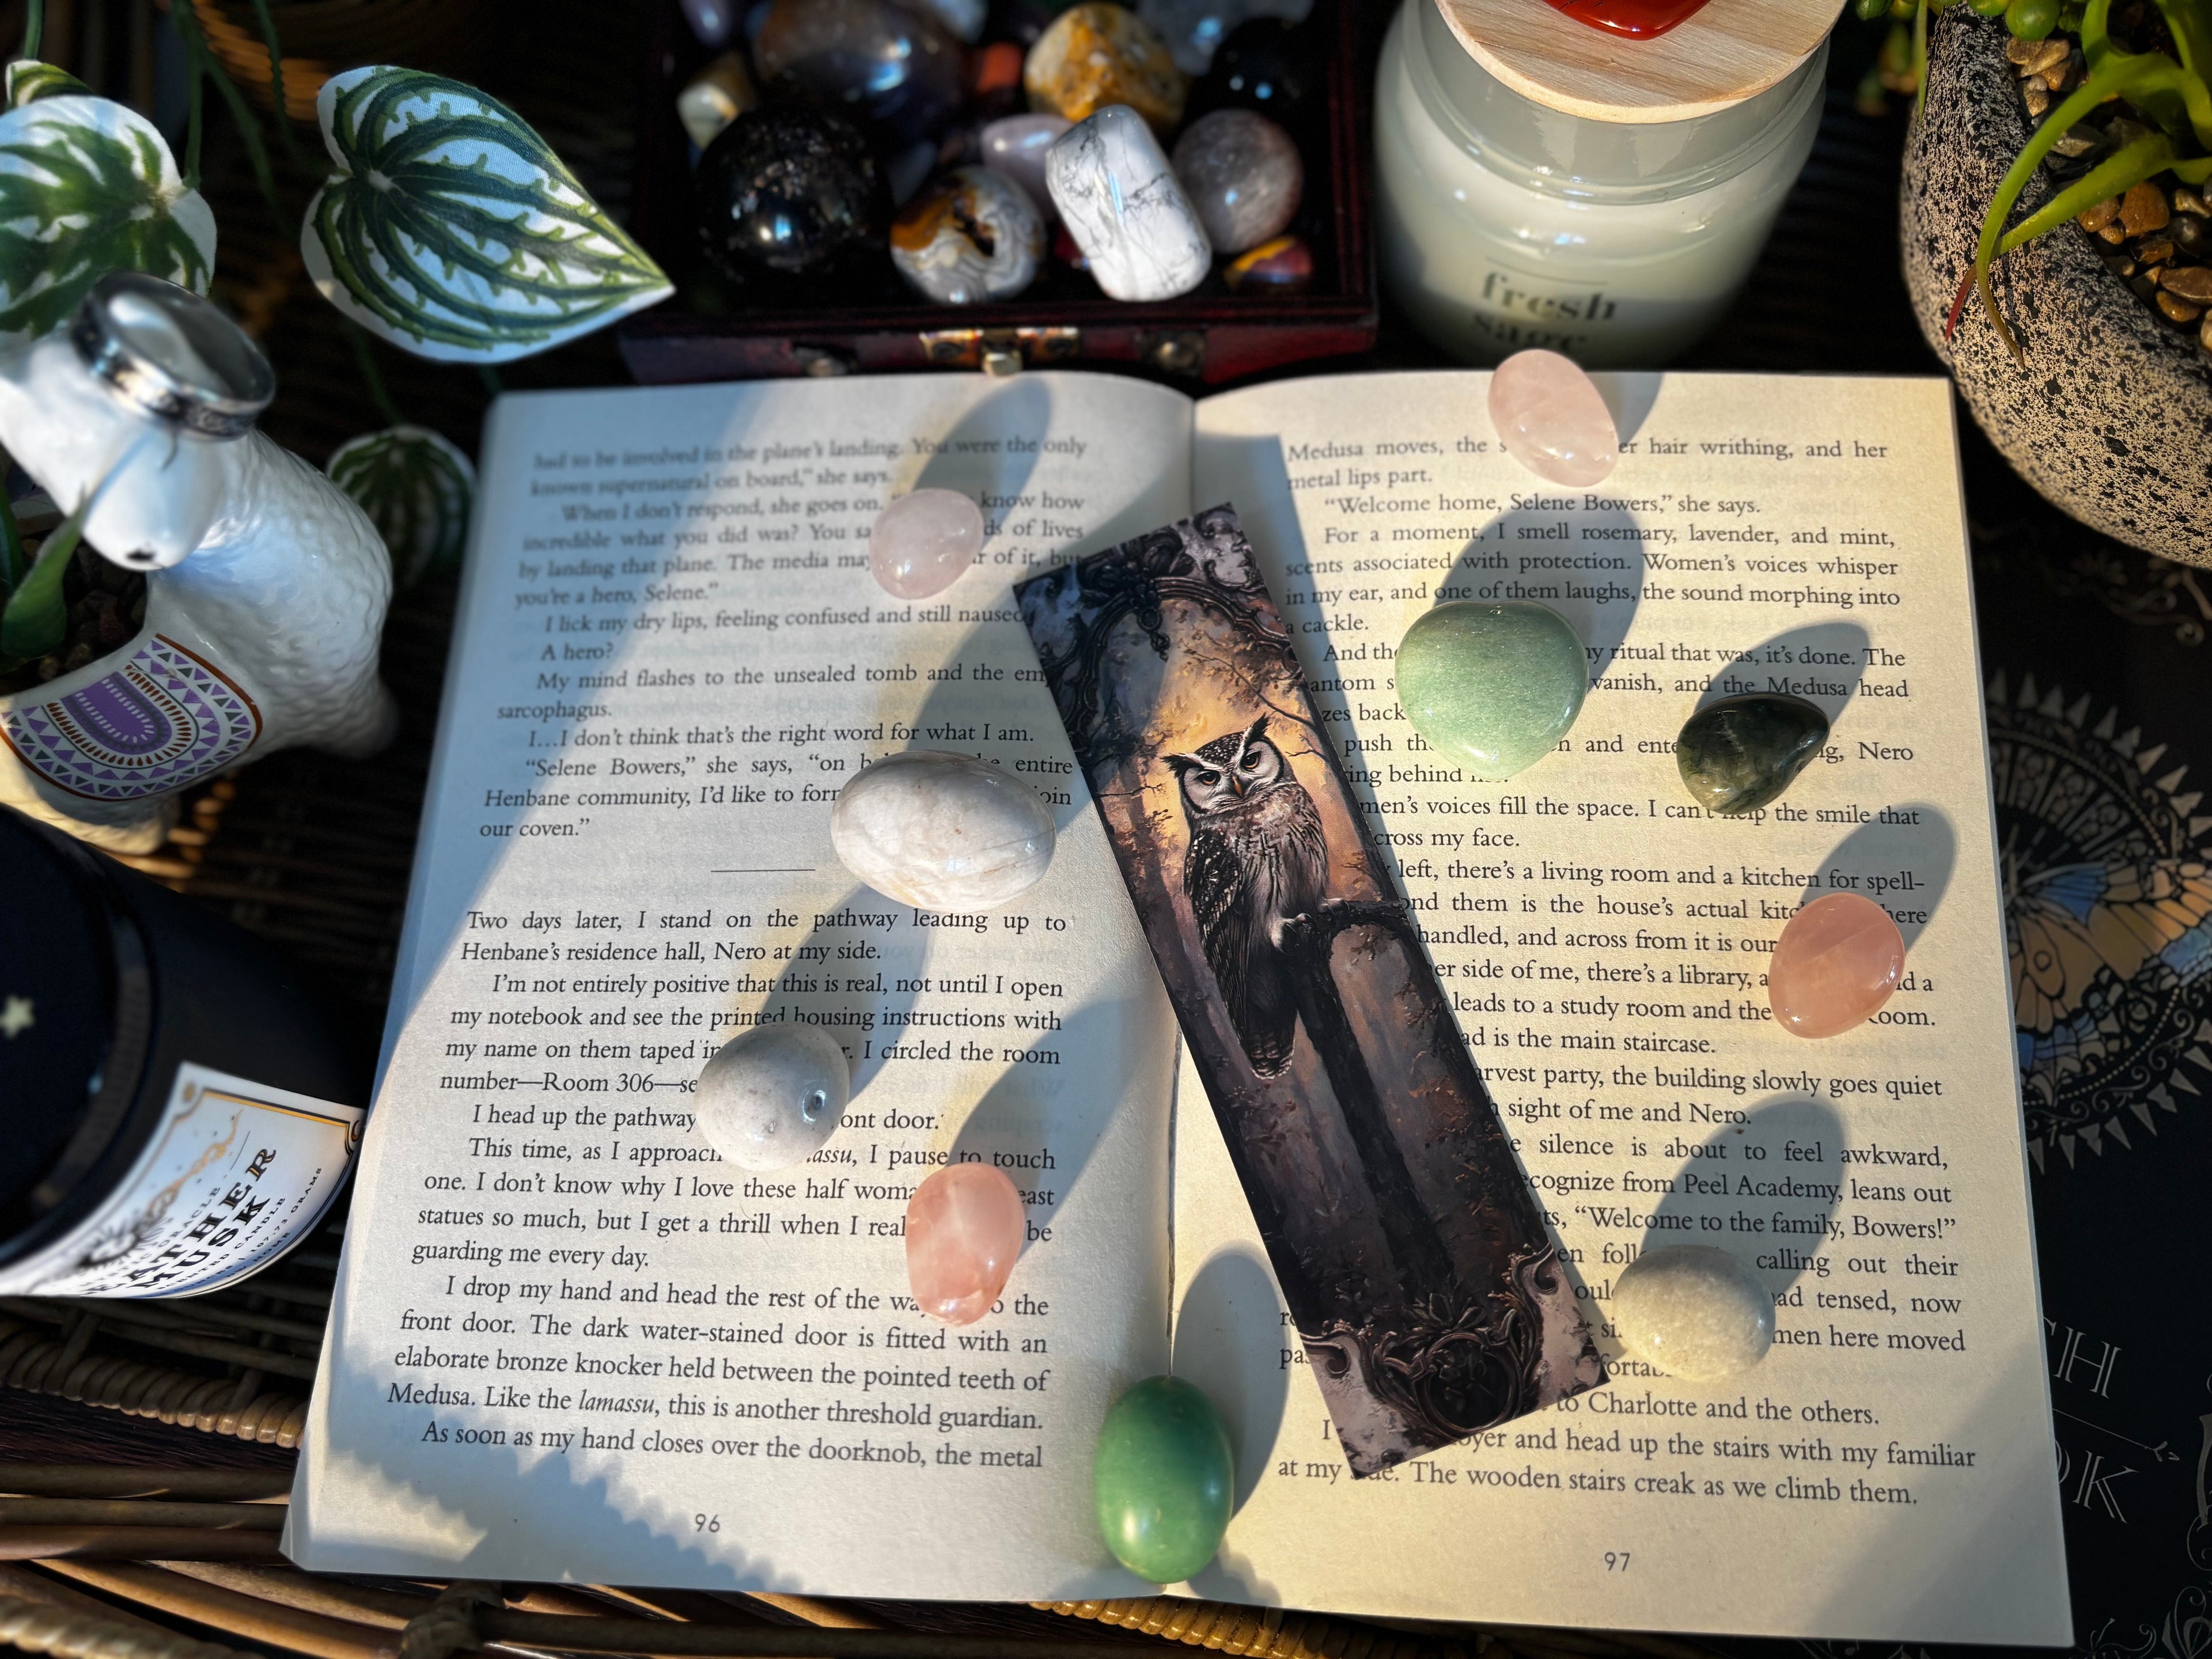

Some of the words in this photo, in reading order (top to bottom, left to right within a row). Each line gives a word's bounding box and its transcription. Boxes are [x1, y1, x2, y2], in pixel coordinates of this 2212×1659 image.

[1482, 272, 1616, 320] fresh
[1290, 442, 1362, 459] Medusa
[1377, 443, 1443, 454] moves,
[1457, 437, 1487, 452] the
[1619, 440, 1637, 453] er
[1650, 438, 1688, 454] hair
[1700, 438, 1793, 460] writhing,
[1806, 440, 1842, 457] and
[1854, 441, 1887, 457] her
[1289, 470, 1339, 489] metal
[1349, 469, 1380, 488] lips
[1389, 471, 1431, 488] part.
[1325, 497, 1430, 513] “Welcome
[1440, 494, 1501, 511] home,
[1511, 493, 1575, 510] Selene
[1584, 495, 1672, 513] Bowers,”
[1679, 495, 1710, 512] she
[1718, 501, 1760, 517] says.
[1287, 561, 1343, 575] scents
[1354, 552, 1452, 571] associated
[1462, 551, 1509, 569] with
[1519, 552, 1631, 574] protection.
[1641, 554, 1735, 571] Women’s
[1745, 556, 1807, 573] voices
[1817, 556, 1898, 579] whisper
[515, 586, 570, 612] you’re
[576, 592, 585, 603] a
[592, 586, 637, 604] hero,
[643, 582, 719, 603] Selene.”
[537, 673, 569, 688] My
[578, 671, 627, 688] mind
[637, 669, 694, 686] flashes
[706, 673, 724, 684] to
[735, 668, 763, 684] the
[775, 664, 855, 683] unsealed
[866, 664, 917, 681] tomb
[927, 663, 962, 680] and
[973, 663, 1003, 680] the
[1014, 669, 1050, 688] em
[499, 701, 611, 722] sarcophagus.
[1399, 859, 1442, 881] left,
[1448, 859, 1514, 879] there’s
[1523, 868, 1534, 879] a
[1541, 861, 1603, 887] living
[1611, 869, 1670, 882] room
[1677, 865, 1715, 884] and
[1723, 872, 1733, 885] a
[1741, 866, 1821, 888] kitchen
[1828, 869, 1859, 888] for
[467, 911, 507, 929] Two
[522, 911, 561, 934] days
[575, 911, 622, 931] later,
[638, 911, 646, 928] I
[660, 910, 711, 928] stand
[726, 915, 752, 927] on
[767, 908, 798, 927] the
[812, 908, 898, 932] pathway
[912, 908, 988, 933] leading
[1003, 916, 1029, 934] up
[1045, 916, 1066, 931] to
[450, 1012, 482, 1029] my
[488, 1006, 583, 1025] notebook
[590, 1006, 626, 1025] and
[633, 1013, 663, 1025] see
[669, 1006, 703, 1025] the
[709, 1006, 785, 1031] printed
[794, 1005, 876, 1031] housing
[882, 1006, 1006, 1028] instructions
[1014, 1010, 1062, 1031] with
[440, 1070, 609, 1092] number—Room
[615, 1073, 698, 1093] 306—se
[1540, 1133, 1613, 1155] silence
[1631, 1138, 1647, 1156] is
[1665, 1137, 1726, 1159] about
[1744, 1144, 1766, 1160] to
[1784, 1141, 1824, 1162] feel
[1841, 1143, 1948, 1171] awkward,
[75, 1148, 276, 1296] EATHER
[157, 1187, 221, 1248] ORACLE
[1575, 1206, 1693, 1230] “Welcome
[1699, 1214, 1723, 1231] to
[1729, 1210, 1764, 1232] the
[1771, 1211, 1846, 1241] family,
[1851, 1215, 1955, 1239] Bowers!”
[125, 1195, 271, 1289] MUSK
[411, 1240, 503, 1267] guarding
[509, 1248, 541, 1263] me
[549, 1249, 605, 1271] every
[612, 1245, 648, 1272] day.
[400, 1309, 452, 1331] front
[463, 1311, 515, 1334] door.
[530, 1314, 571, 1335] The
[583, 1316, 629, 1338] dark
[641, 1323, 783, 1344] water-stained
[795, 1324, 847, 1346] door
[858, 1326, 873, 1347] is
[886, 1326, 945, 1349] fitted
[958, 1330, 1009, 1351] with
[1021, 1339, 1047, 1353] an
[387, 1382, 475, 1406] Medusa.
[484, 1386, 531, 1408] Like
[538, 1388, 571, 1410] the
[579, 1389, 660, 1417] lamassu,
[669, 1393, 705, 1415] this
[713, 1395, 728, 1416] is
[735, 1397, 821, 1422] another
[827, 1400, 933, 1425] threshold
[938, 1406, 1042, 1433] guardian.
[421, 1421, 448, 1442] As
[455, 1429, 506, 1444] soon
[514, 1431, 533, 1446] as
[540, 1433, 575, 1454] my
[581, 1427, 635, 1450] hand
[642, 1430, 703, 1453] closes
[712, 1440, 759, 1456] over
[767, 1435, 800, 1458] the
[809, 1437, 926, 1467] doorknob,
[936, 1442, 972, 1465] the
[980, 1445, 1042, 1467] metal
[1323, 1419, 1330, 1440] I
[1516, 1427, 1557, 1449] and
[1566, 1428, 1621, 1452] head
[1630, 1438, 1658, 1460] up
[1668, 1432, 1703, 1455] the
[1714, 1437, 1769, 1459] stairs
[1778, 1438, 1832, 1461] with
[1841, 1447, 1878, 1469] my
[1887, 1441, 1976, 1467] familiar
[1279, 1460, 1298, 1476] at
[1306, 1463, 1342, 1485] my
[1410, 1460, 1457, 1484] The
[1467, 1465, 1562, 1491] wooden
[1570, 1469, 1625, 1491] stairs
[1634, 1471, 1695, 1494] creak
[1705, 1480, 1724, 1495] as
[1733, 1482, 1766, 1498] we
[1775, 1476, 1840, 1501] climb
[1850, 1479, 1916, 1504] them.
[696, 1513, 720, 1533] 96
[1605, 1552, 1630, 1571] 97
